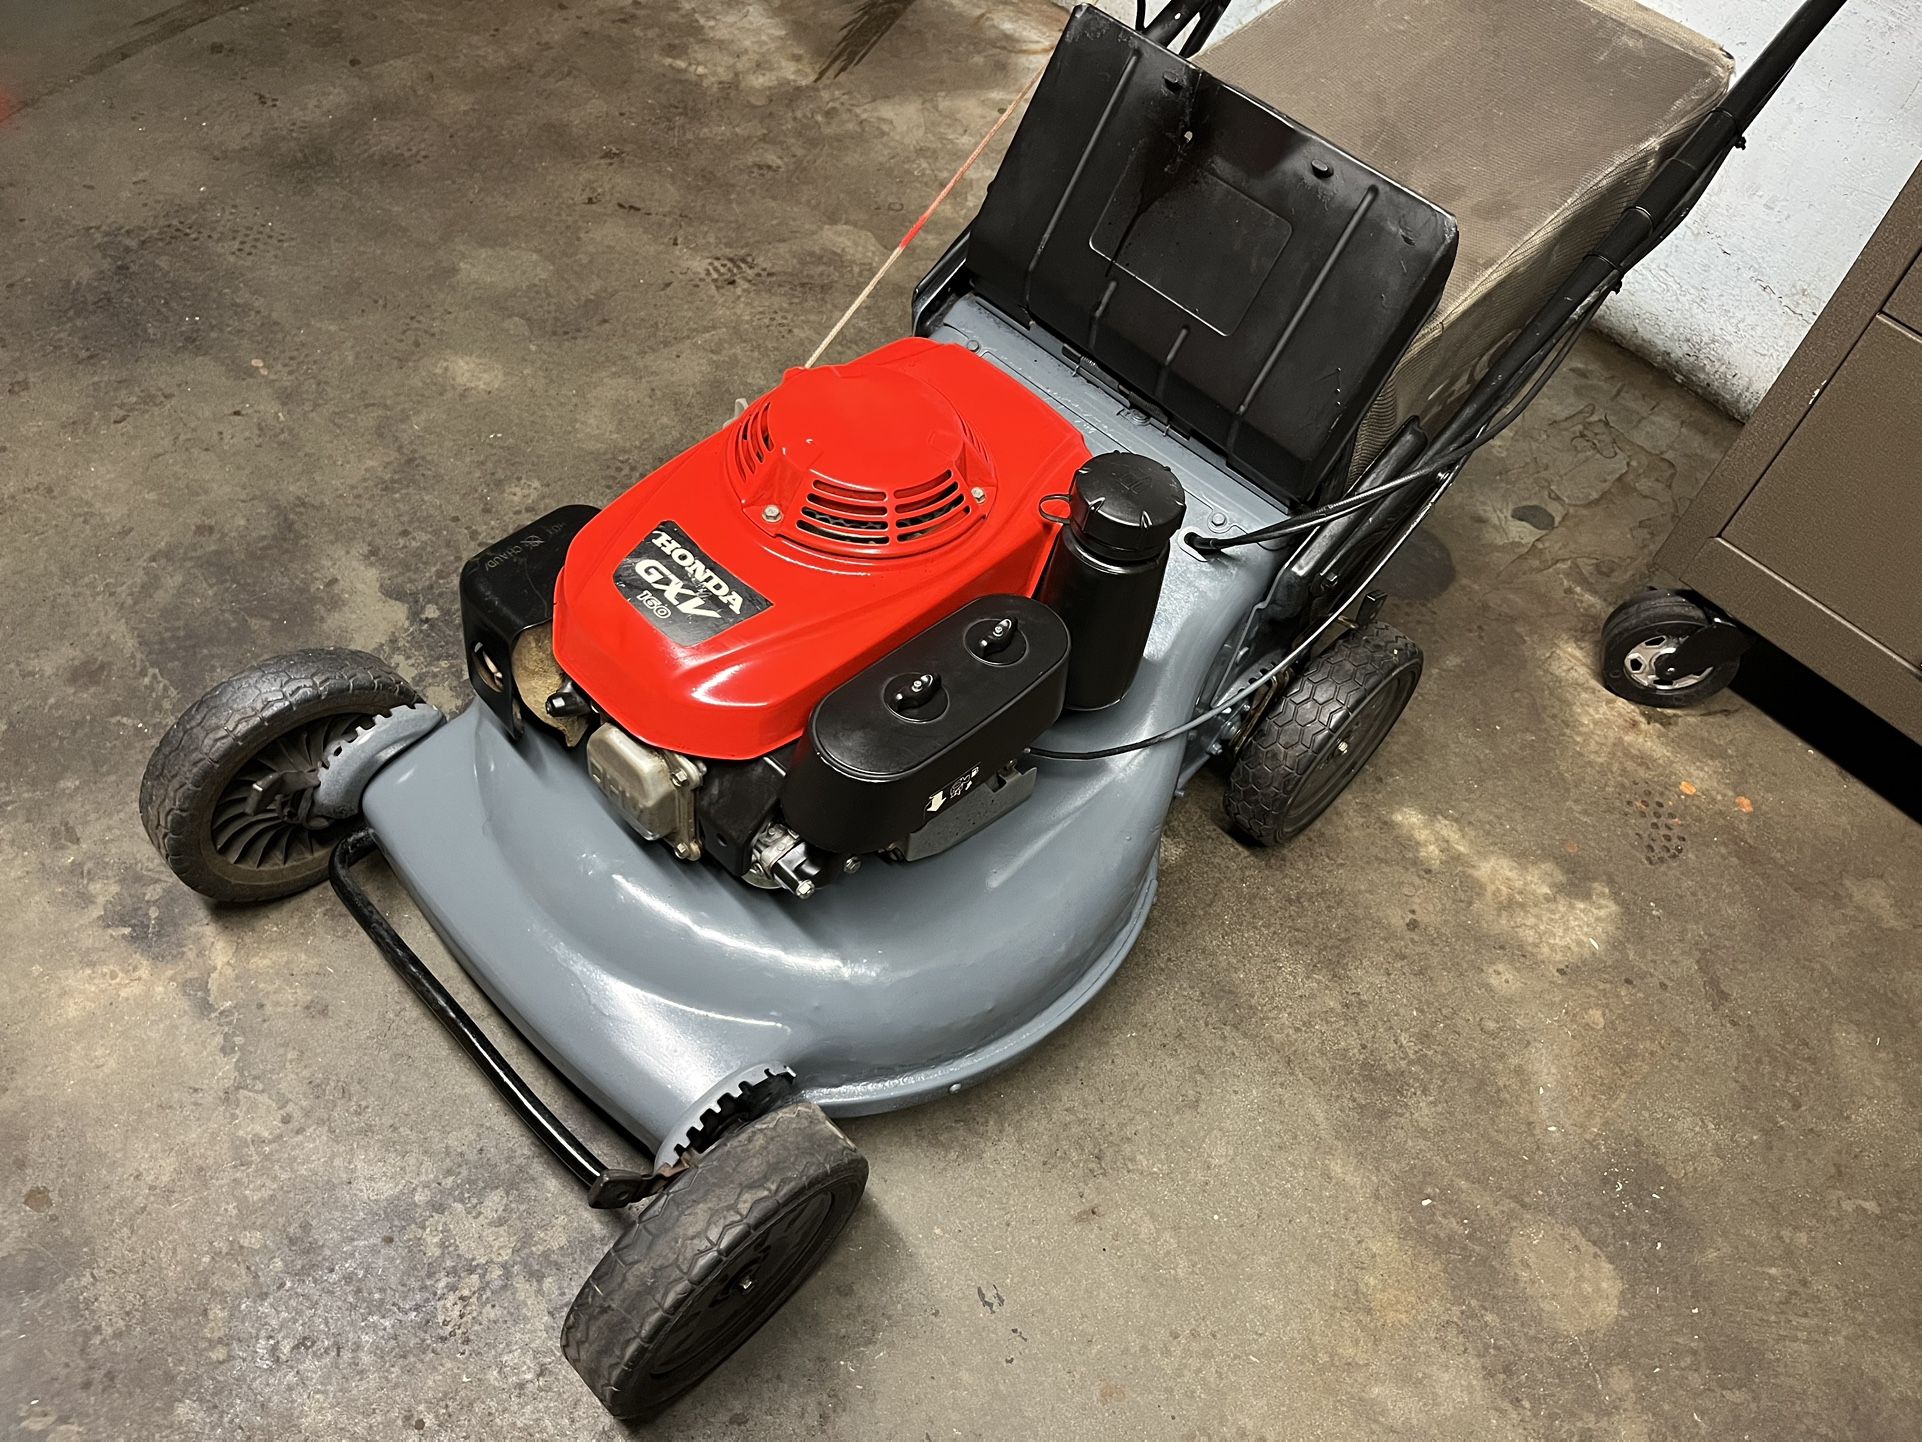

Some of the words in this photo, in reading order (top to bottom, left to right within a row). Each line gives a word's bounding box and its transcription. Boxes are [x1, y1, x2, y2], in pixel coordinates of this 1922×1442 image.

[635, 559, 722, 618] GXV
[651, 530, 744, 614] HONDA
[636, 590, 672, 619] 160
